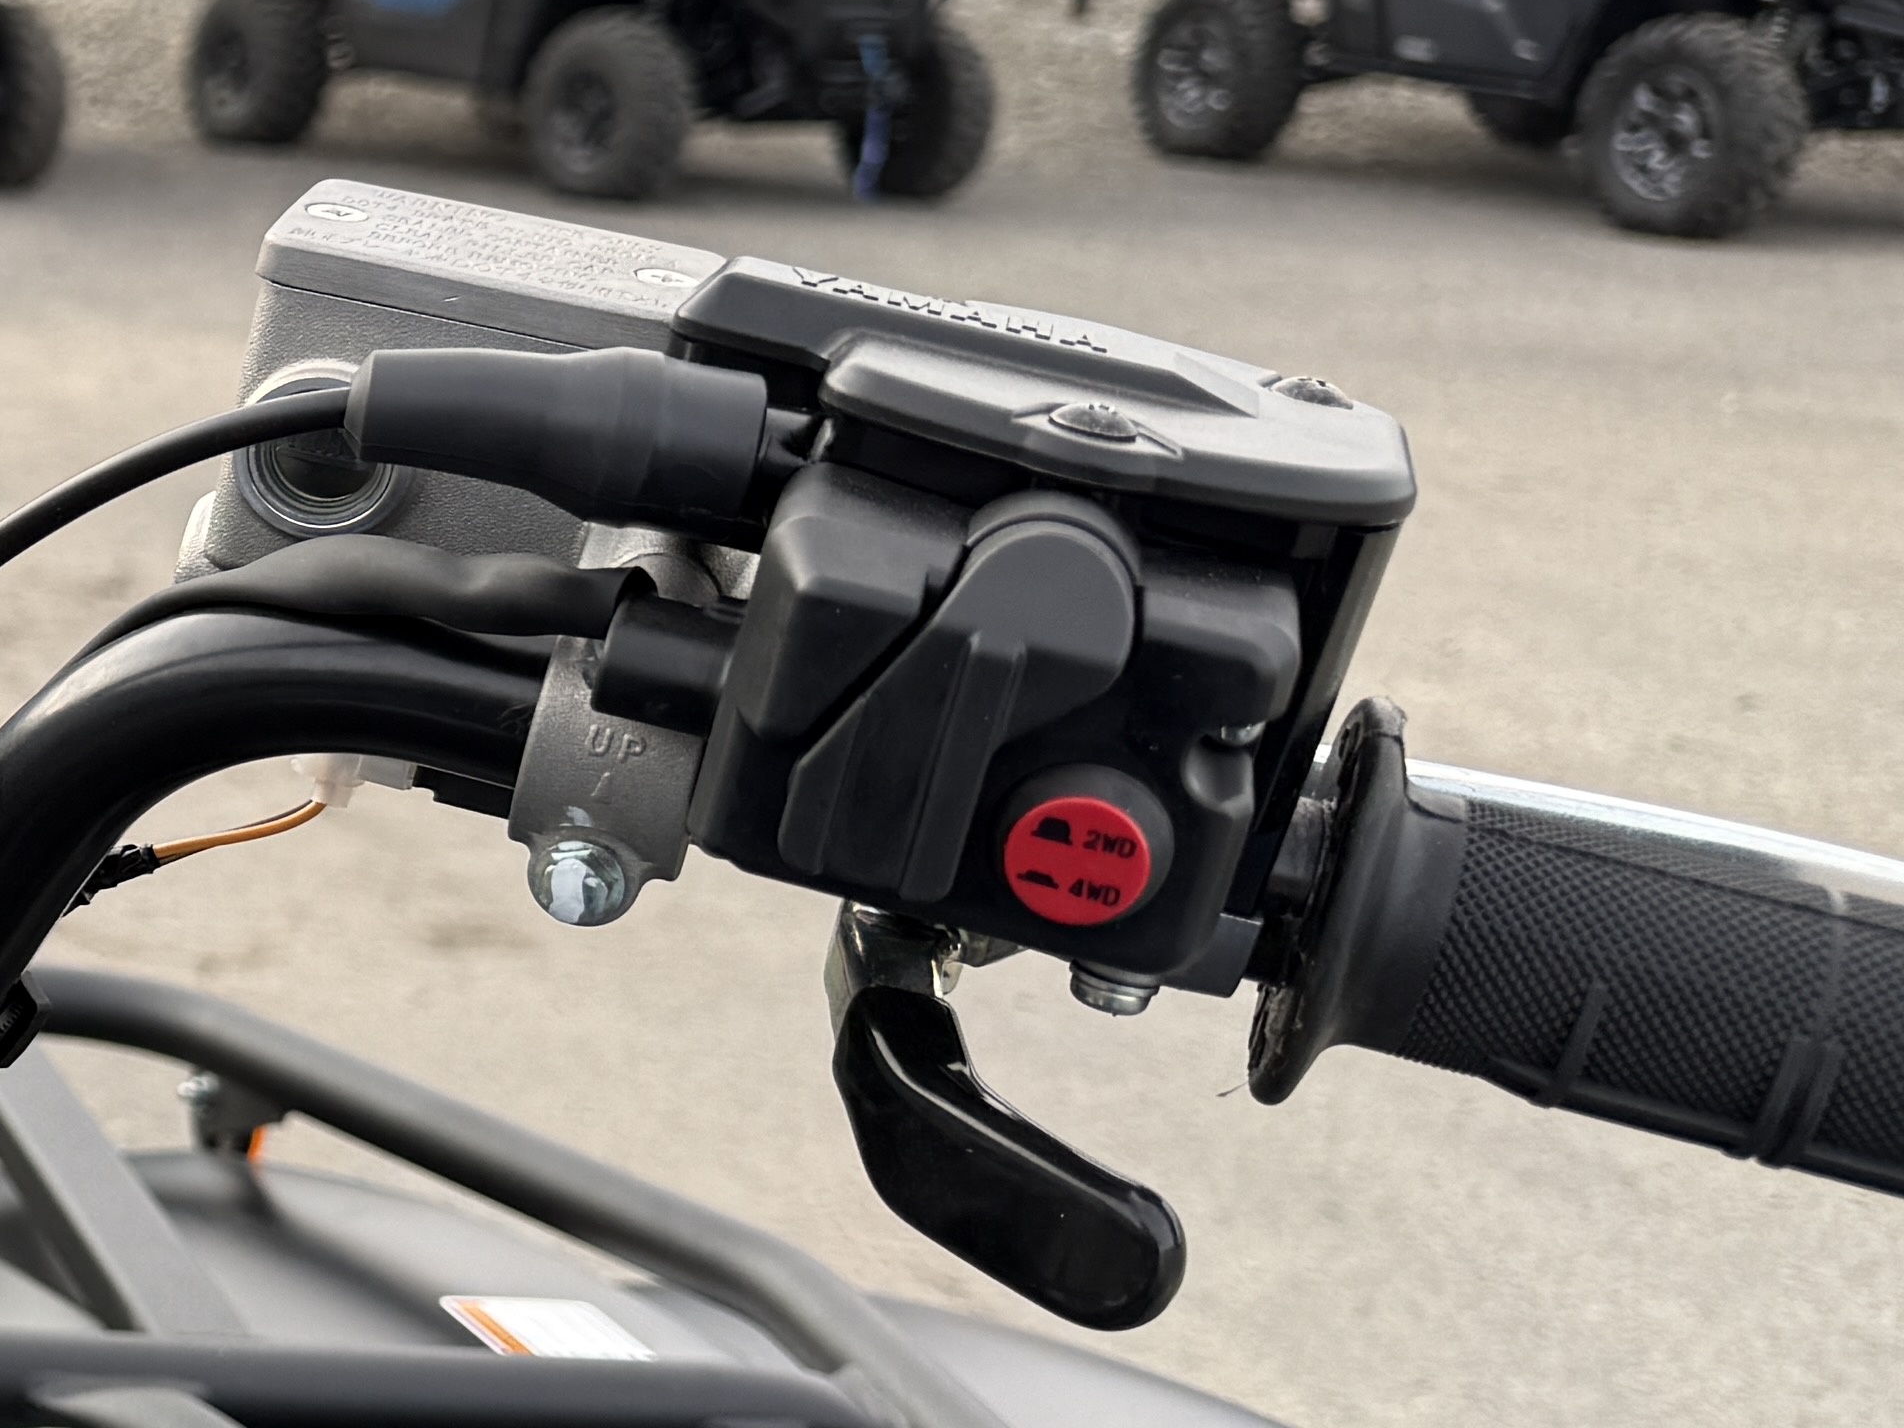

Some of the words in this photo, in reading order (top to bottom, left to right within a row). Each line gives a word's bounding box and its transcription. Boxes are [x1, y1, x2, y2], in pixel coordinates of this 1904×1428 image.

[792, 266, 1107, 353] YAMAHA
[585, 724, 647, 763] UP
[1083, 829, 1138, 859] 2WD
[1069, 878, 1121, 907] 4WD
